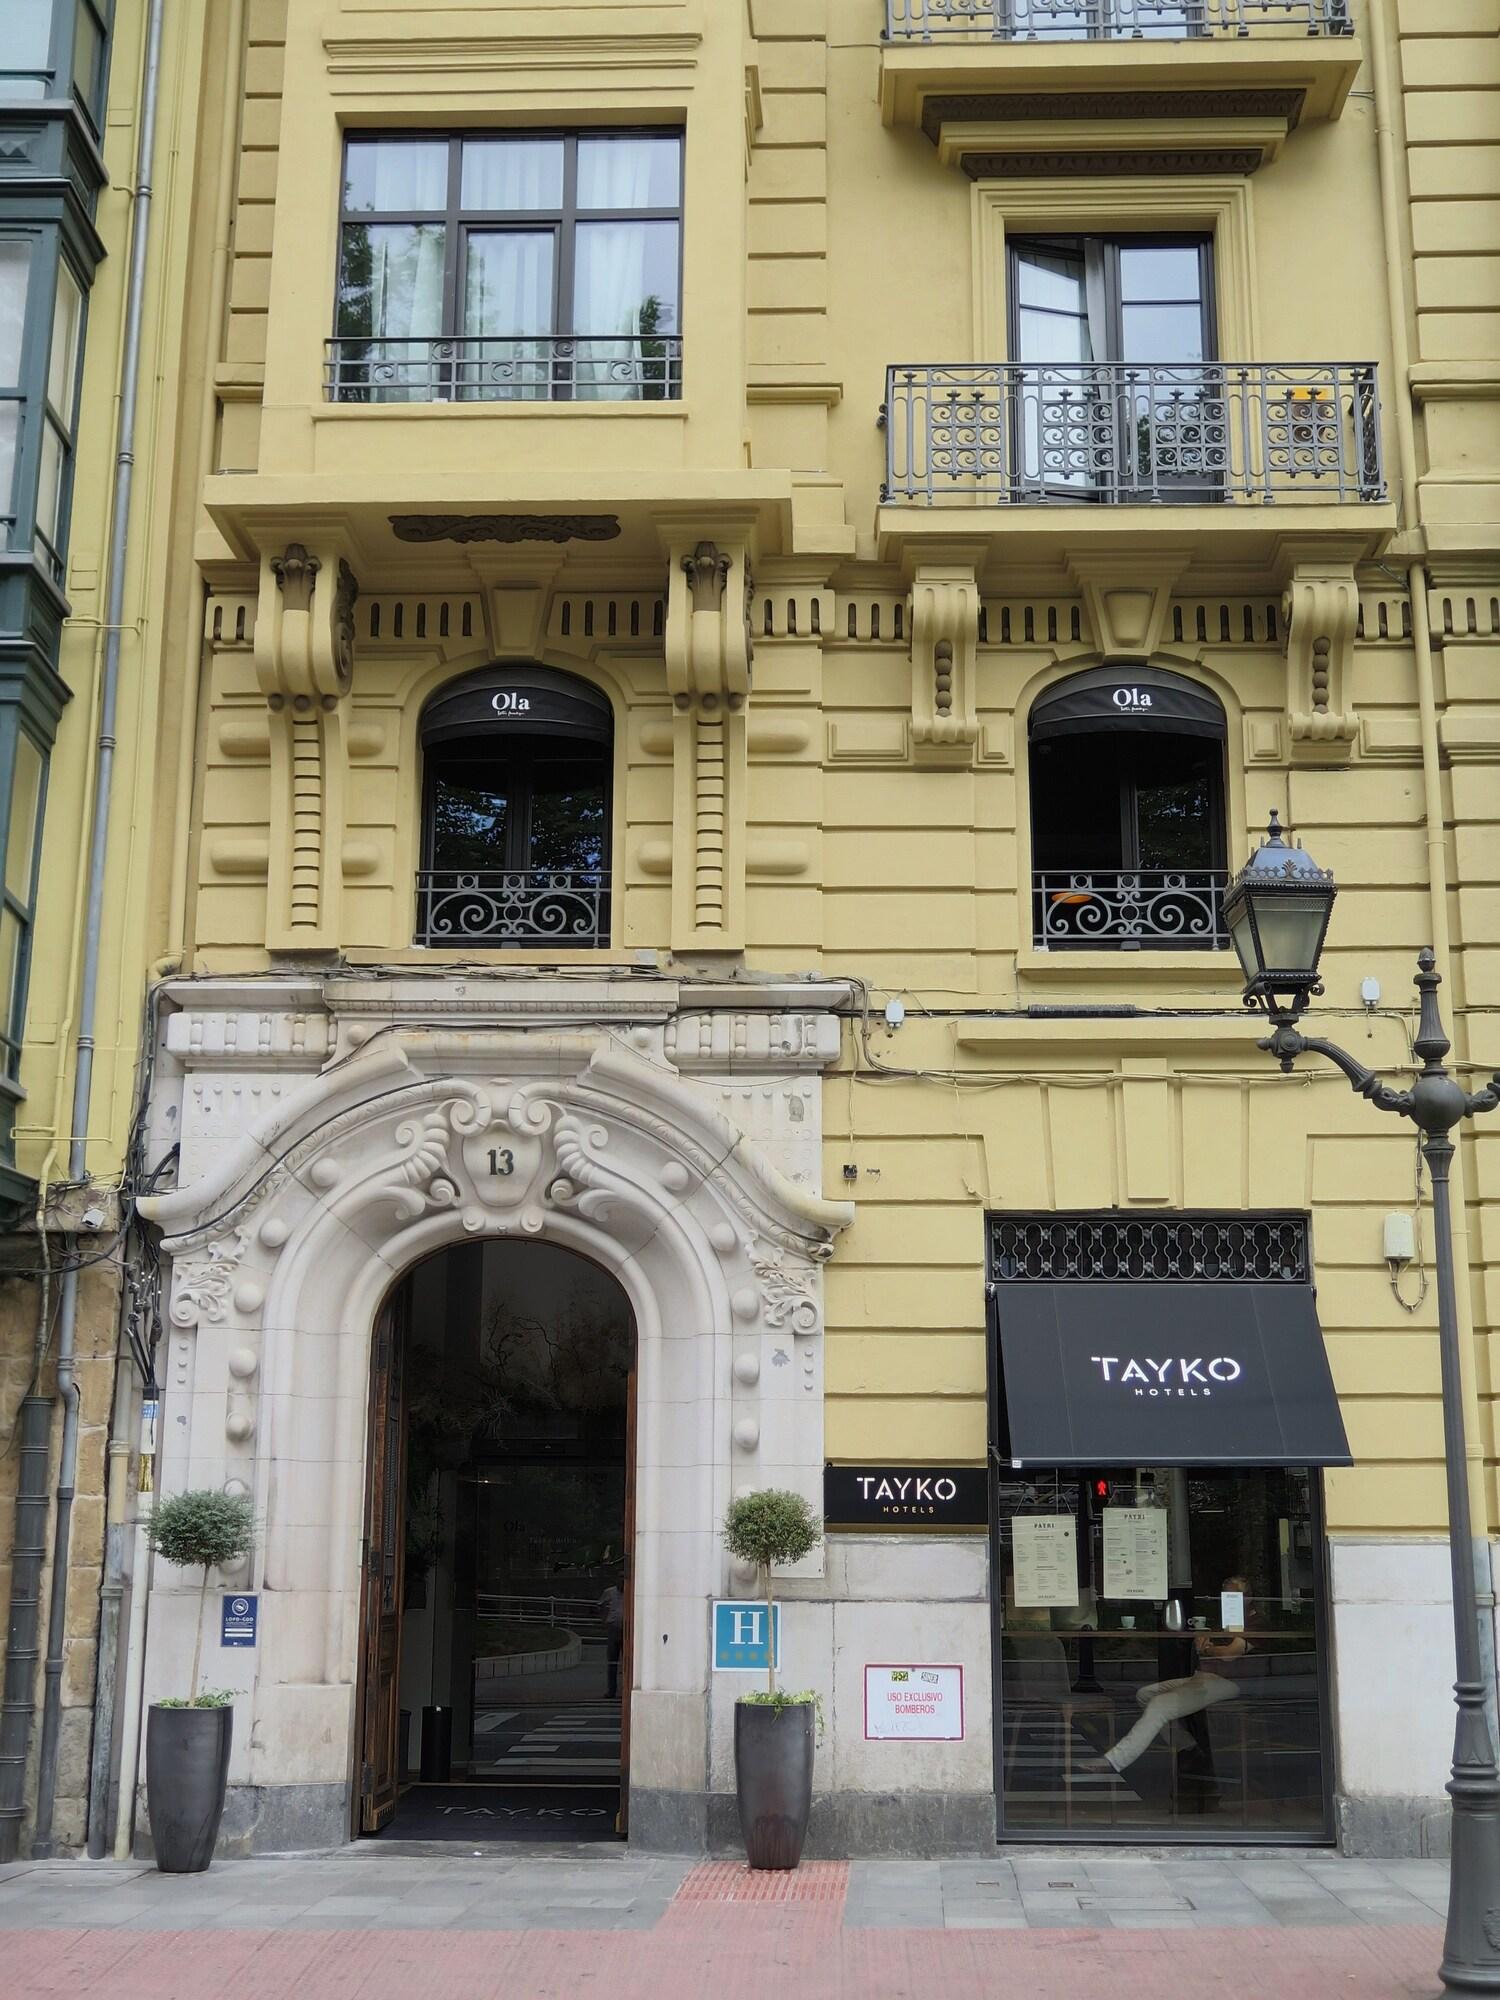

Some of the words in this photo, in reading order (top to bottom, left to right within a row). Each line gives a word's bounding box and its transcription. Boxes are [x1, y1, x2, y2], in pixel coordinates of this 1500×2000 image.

[491, 692, 530, 710] Ola
[1112, 688, 1152, 706] Ola
[487, 1149, 514, 1175] 13
[1091, 1357, 1241, 1382] TAYKO
[1135, 1388, 1211, 1396] HOTELS
[856, 1477, 956, 1500] TAYKO
[729, 1611, 764, 1645] H
[887, 1692, 902, 1701] USO
[904, 1692, 943, 1702] EXCLUSIVO
[895, 1705, 935, 1714] BOMBEROS
[435, 1806, 607, 1816] TAYKO
